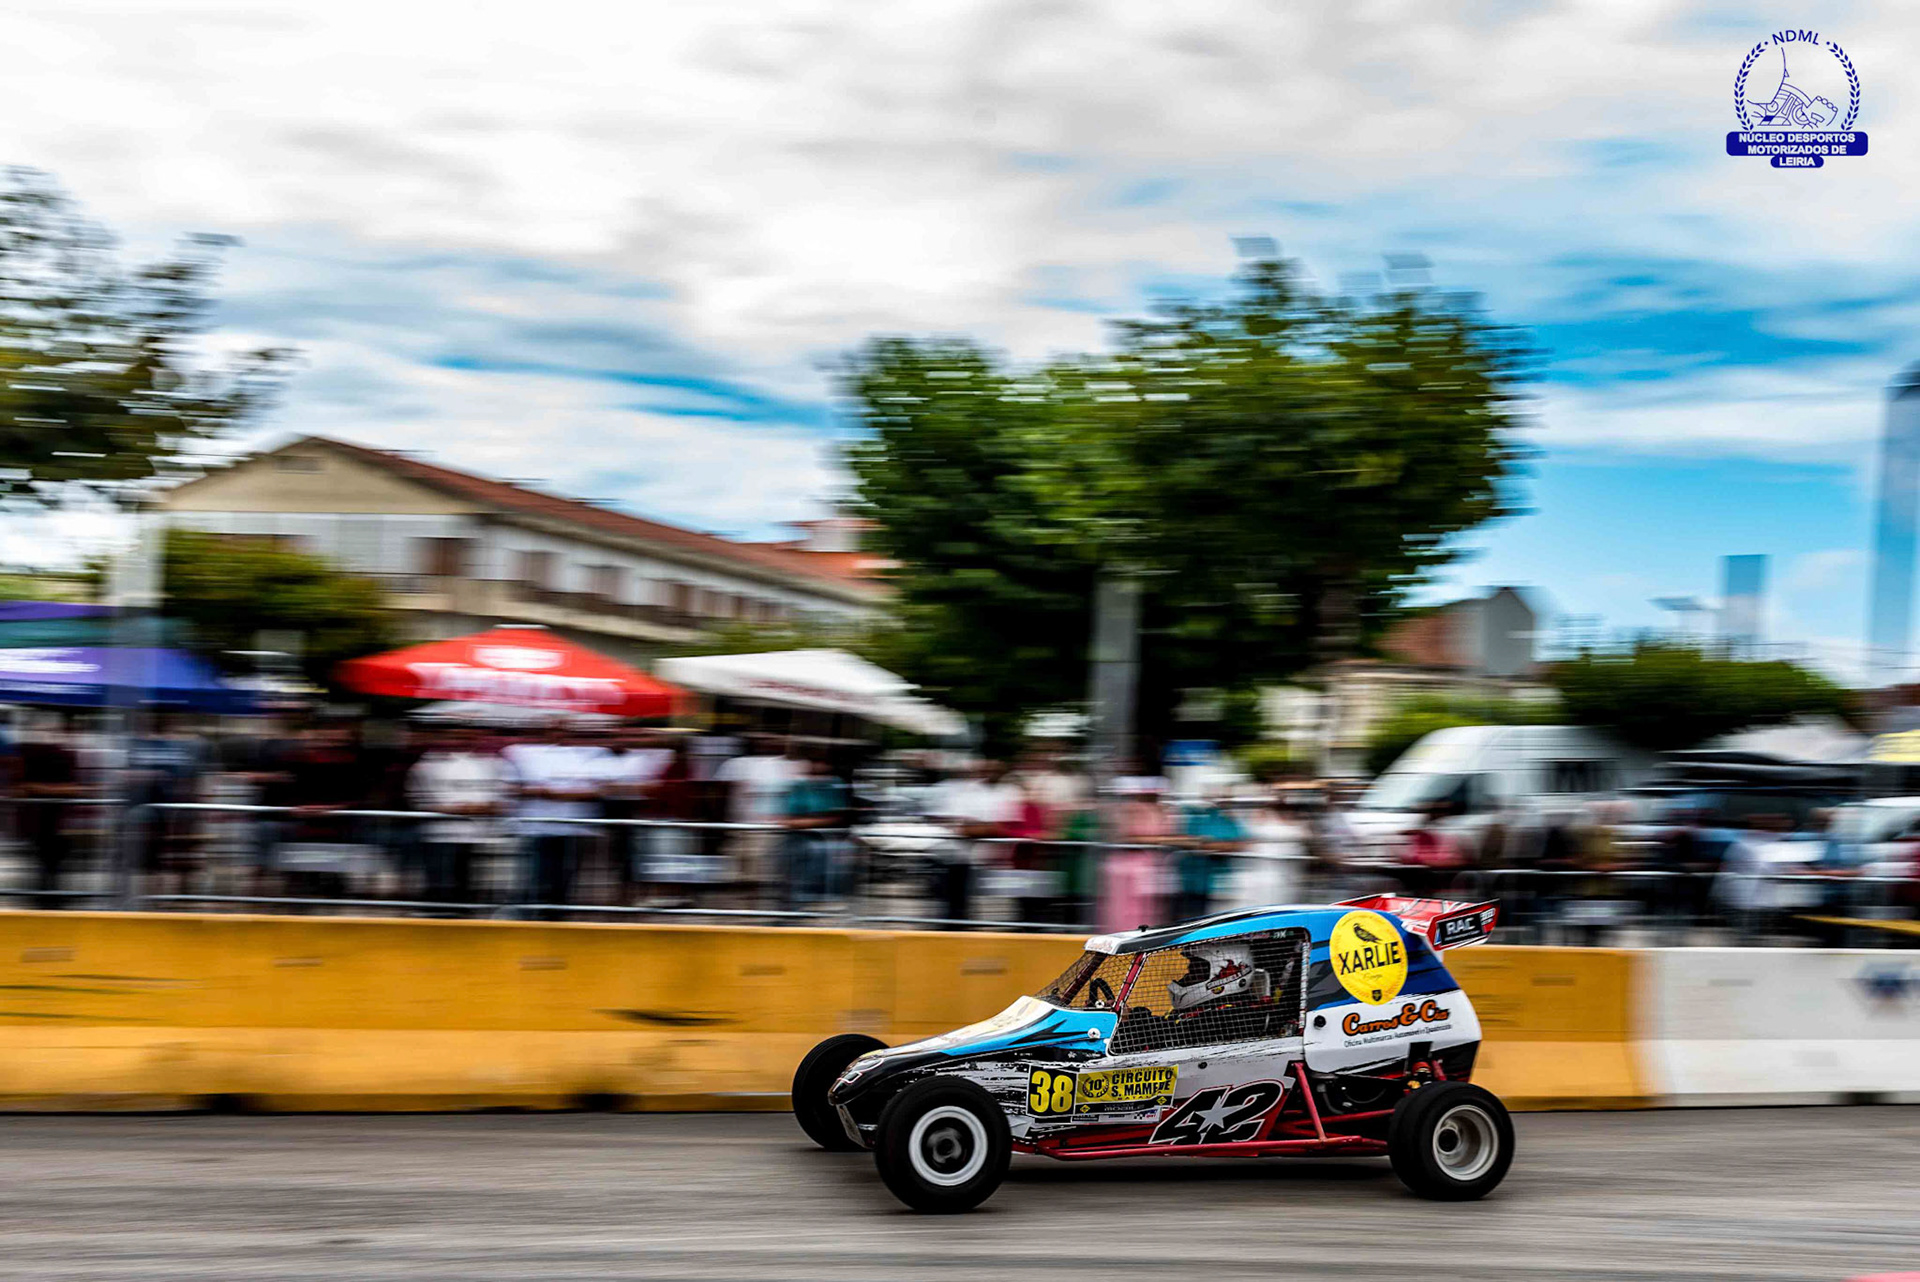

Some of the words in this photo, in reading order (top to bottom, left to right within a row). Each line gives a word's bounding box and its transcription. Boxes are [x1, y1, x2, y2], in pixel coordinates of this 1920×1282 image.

[1445, 917, 1476, 935] RAC
[1338, 941, 1402, 976] XARLIE
[1342, 1012, 1399, 1036] Carros
[1111, 1069, 1174, 1085] CIRCUITO
[1029, 1070, 1074, 1113] 38
[1111, 1085, 1122, 1097] S.
[1148, 1078, 1285, 1145] 42
